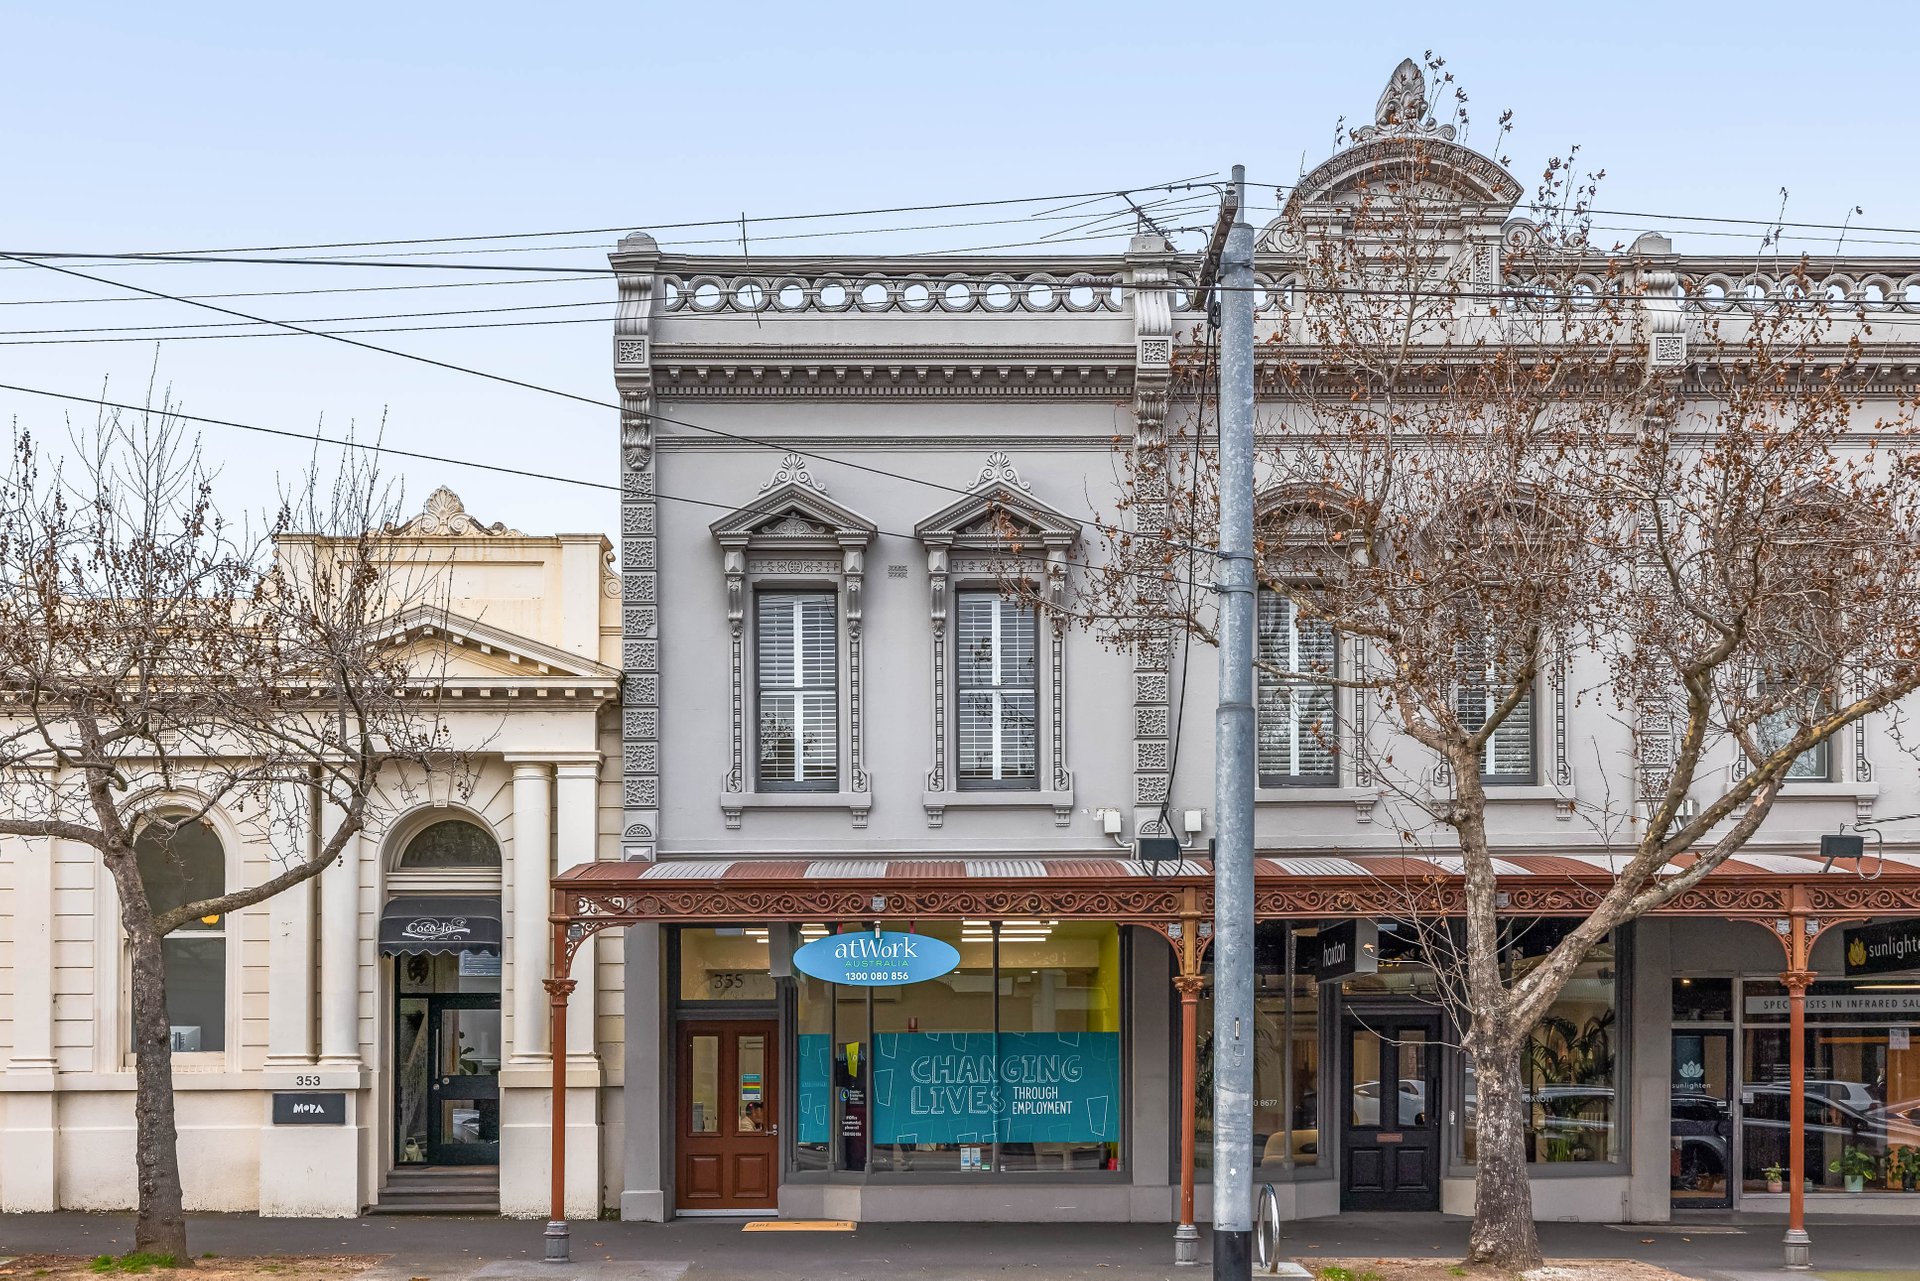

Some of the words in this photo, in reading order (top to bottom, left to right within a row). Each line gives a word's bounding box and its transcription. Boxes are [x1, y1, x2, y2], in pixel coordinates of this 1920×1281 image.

[834, 937, 918, 959] atWork
[1322, 941, 1346, 967] hoxton
[714, 974, 743, 989] 355
[845, 972, 868, 981] 1300
[870, 972, 888, 981] 080
[891, 972, 909, 981] 856
[1763, 1000, 1826, 1010] SPECISTS
[1831, 1000, 1842, 1009] IN
[1846, 1000, 1898, 1008] INFRARED
[910, 1054, 1083, 1084] CHANGING
[296, 1075, 321, 1086] 353
[1671, 1082, 1712, 1090] sunlighten
[910, 1085, 1006, 1115] LIVES
[1012, 1086, 1059, 1100] THROUGH
[1012, 1101, 1073, 1115] EMPLOYMENT
